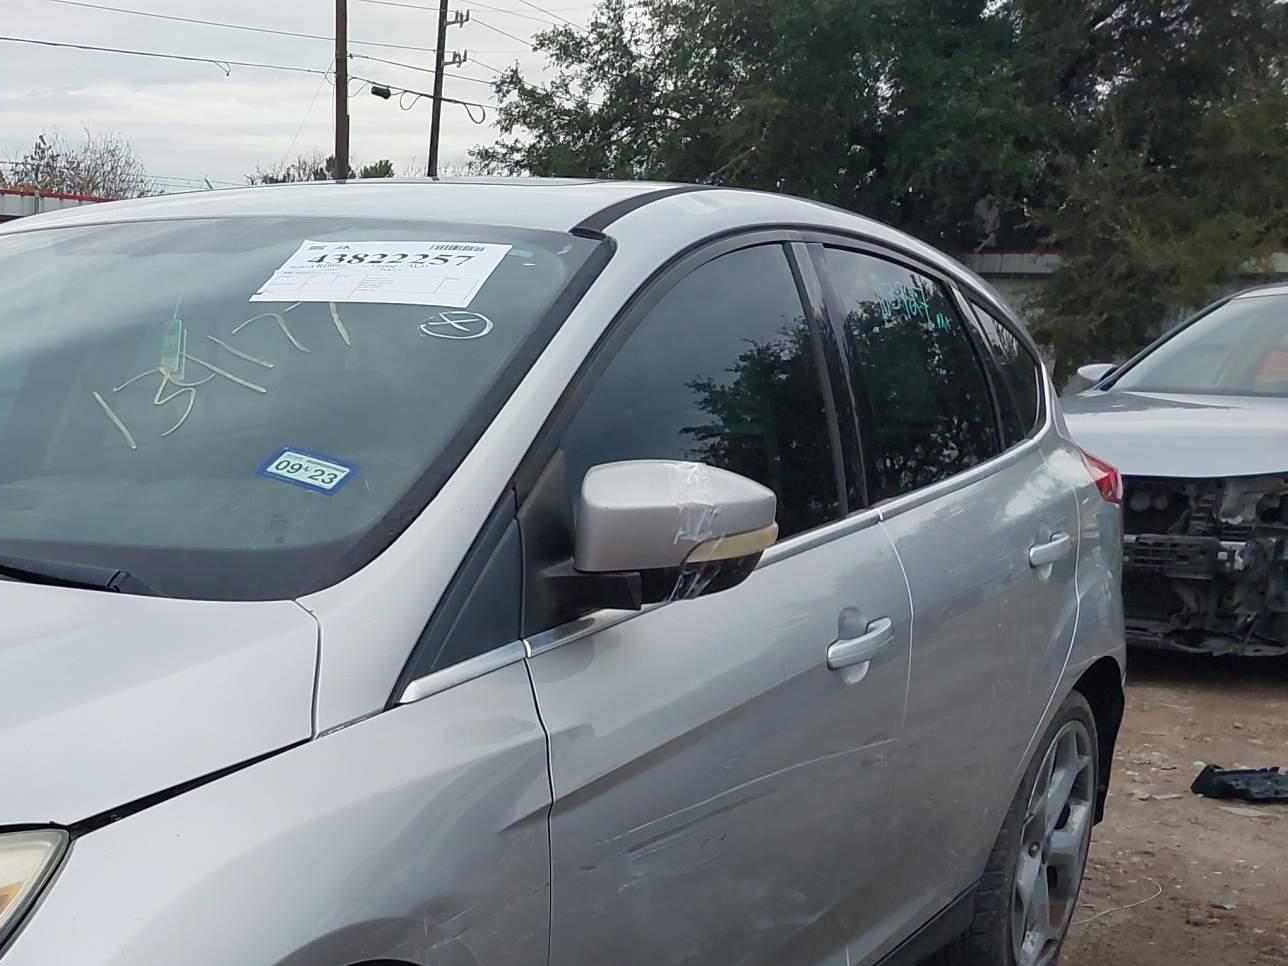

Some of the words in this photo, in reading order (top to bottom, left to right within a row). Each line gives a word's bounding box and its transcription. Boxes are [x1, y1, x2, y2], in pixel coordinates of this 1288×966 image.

[307, 253, 476, 267] 43822257
[275, 460, 303, 474] 09
[308, 469, 338, 485] 23
